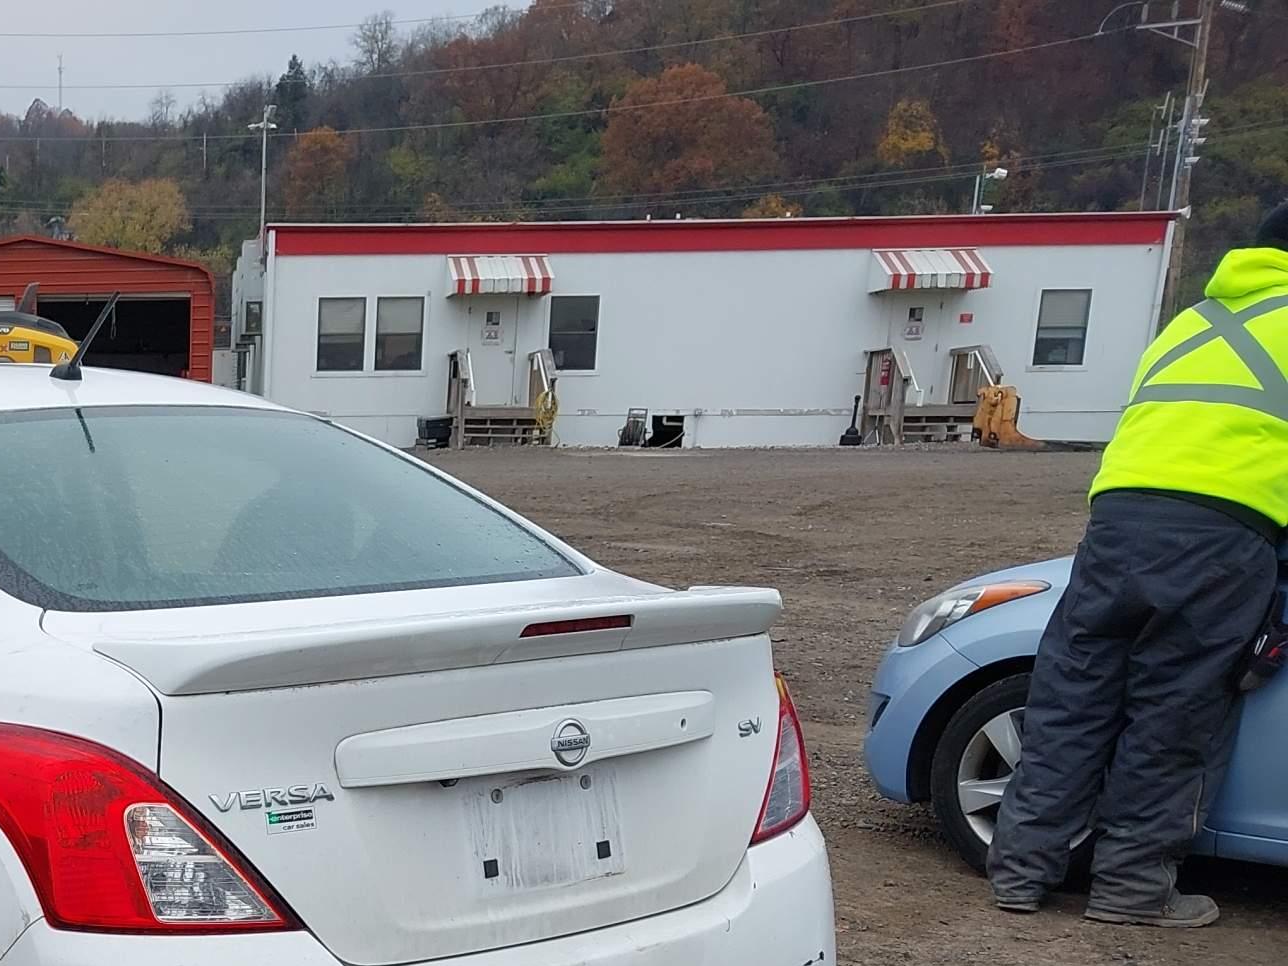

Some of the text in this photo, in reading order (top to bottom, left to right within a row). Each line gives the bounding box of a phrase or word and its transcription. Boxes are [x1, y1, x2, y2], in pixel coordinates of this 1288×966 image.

[737, 716, 762, 738] SV
[557, 735, 589, 748] NISSAN
[208, 783, 335, 813] VERSA
[282, 821, 314, 831] car sales
